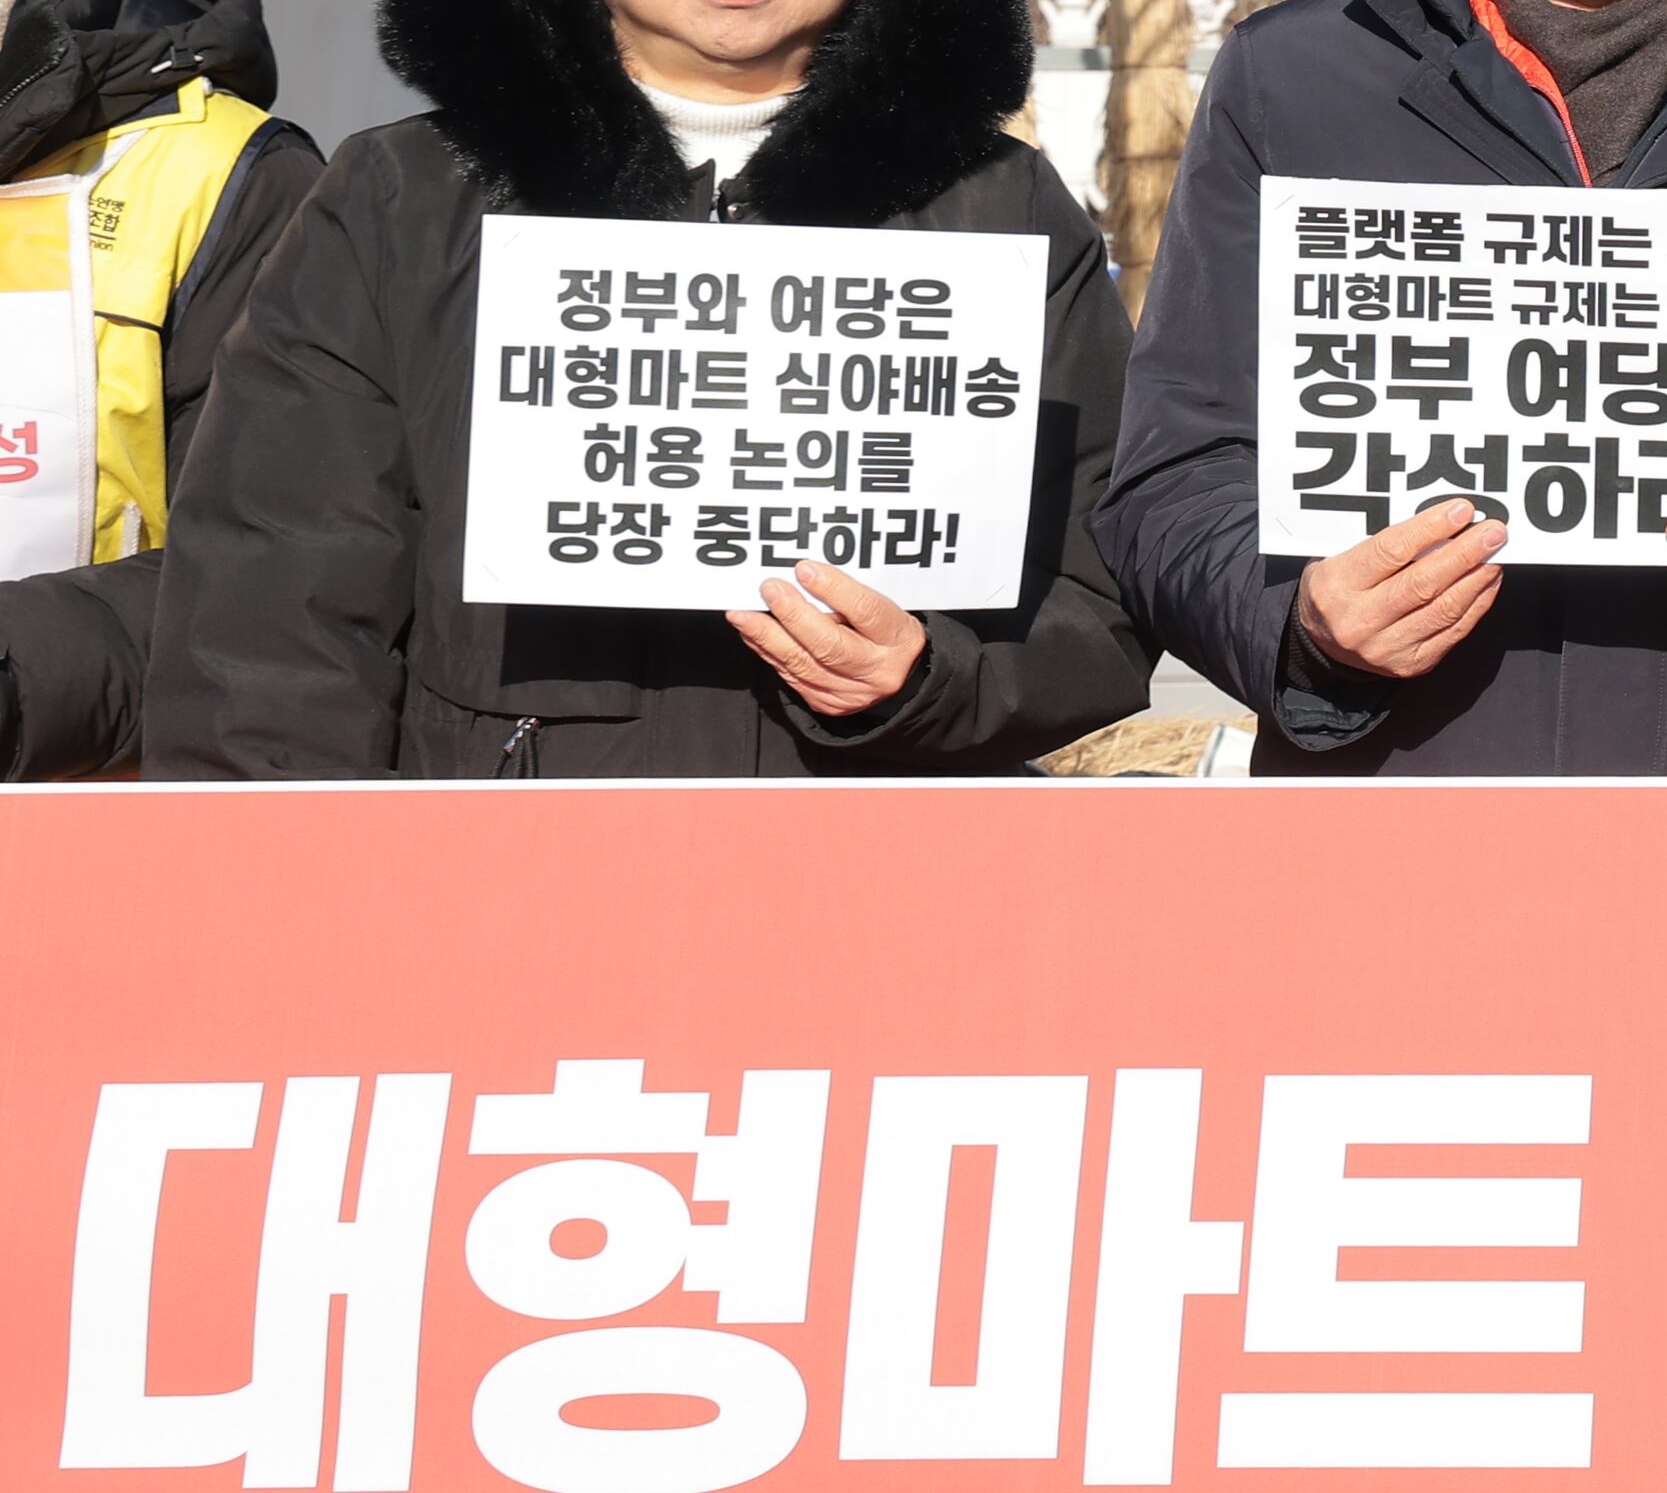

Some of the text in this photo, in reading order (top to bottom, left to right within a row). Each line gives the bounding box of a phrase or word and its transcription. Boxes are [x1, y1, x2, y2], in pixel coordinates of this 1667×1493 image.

[1296, 207, 1464, 262] 플랫폼
[1484, 214, 1651, 268] 규제는
[558, 270, 952, 339] 정부와 여당은
[1295, 273, 1493, 321] 대형마트
[1512, 280, 1659, 328] 규제는
[500, 346, 1019, 418] 대형마트 심야배송
[1294, 334, 1472, 420] 정부
[585, 424, 913, 492] 허용 논의를
[548, 502, 959, 568] 당장 중단하라!
[59, 1059, 1593, 1493] 대형마트
